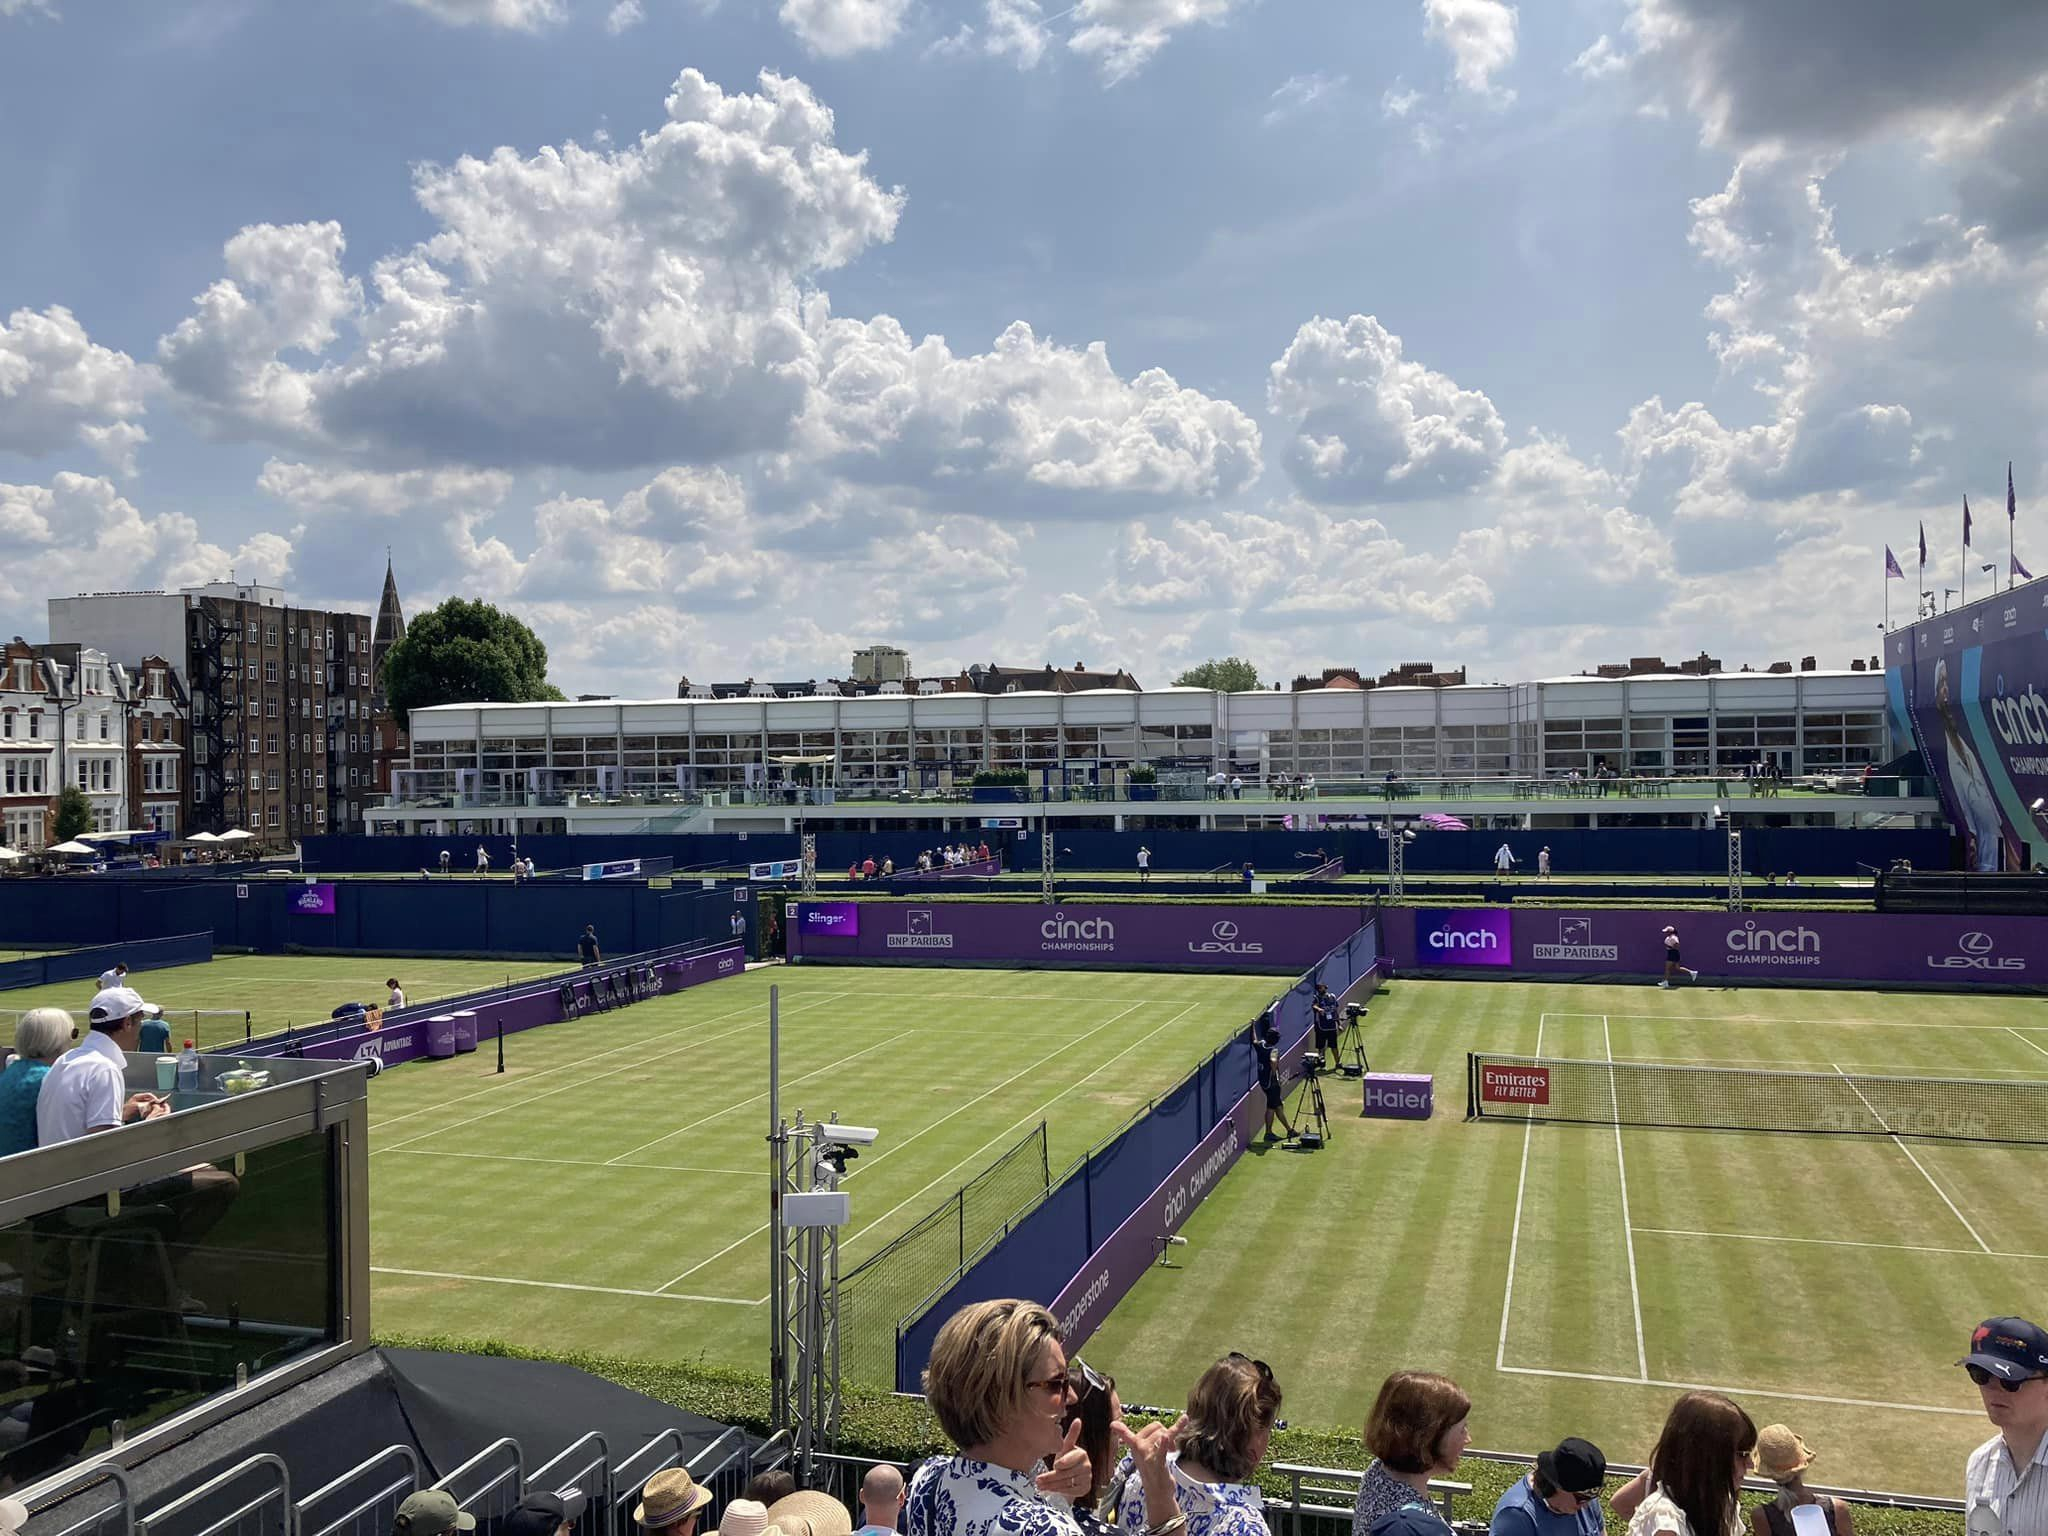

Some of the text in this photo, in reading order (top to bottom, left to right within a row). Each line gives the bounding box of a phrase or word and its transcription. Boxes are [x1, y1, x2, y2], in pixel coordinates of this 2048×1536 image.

[1041, 912, 1115, 940] cinch
[888, 937, 951, 947] BNP PARIBAS
[1428, 924, 1497, 949] cinch
[1726, 920, 1821, 952] cinch
[1041, 942, 1115, 951] CHAMPIONSHIPS
[1188, 942, 1264, 953] LEXUS
[1535, 946, 1616, 959] BNP PARIBAS
[1726, 954, 1821, 966] CHAMPIONSHIPS
[1927, 955, 2026, 970] LEXUS
[361, 1045, 379, 1057] LTA
[1486, 1071, 1545, 1087] Emirates
[1366, 1087, 1428, 1109] Haier
[1494, 1086, 1537, 1098] FLY BETTER
[1164, 1184, 1186, 1227] cinch
